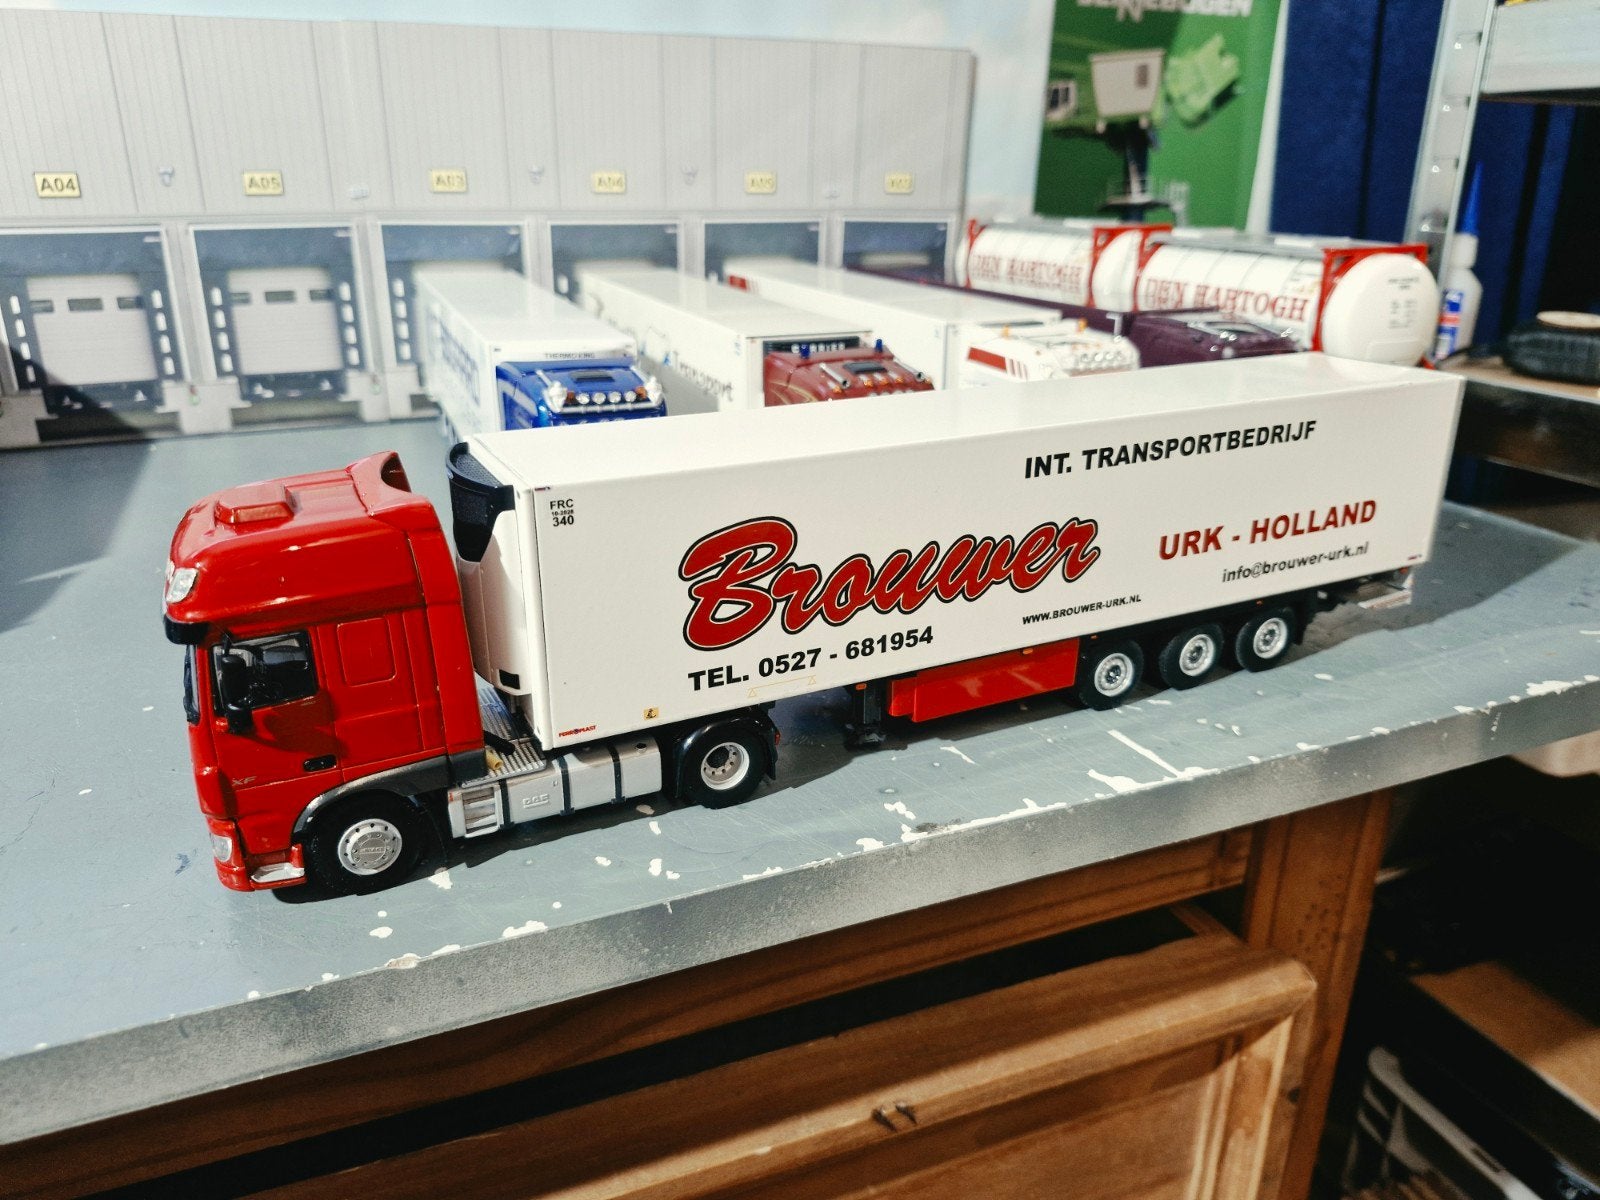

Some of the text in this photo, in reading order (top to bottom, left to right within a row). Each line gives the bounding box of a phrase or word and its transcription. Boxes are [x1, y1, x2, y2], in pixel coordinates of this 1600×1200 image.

[40, 178, 76, 192] A04
[1024, 420, 1317, 479] INT. TRANSPORTBEDRIJF
[550, 498, 574, 510] FRC
[553, 515, 575, 527] 340
[1158, 524, 1225, 561] URK
[1249, 500, 1377, 544] HOLLAND
[678, 515, 1102, 651] Brouwer
[1222, 541, 1369, 583] info@brouwer-urk.nl
[1022, 594, 1142, 624] WWW.BROUWER-URK.NL
[688, 665, 749, 691] TEL.
[758, 648, 821, 677] 0527
[845, 626, 933, 660] 681954
